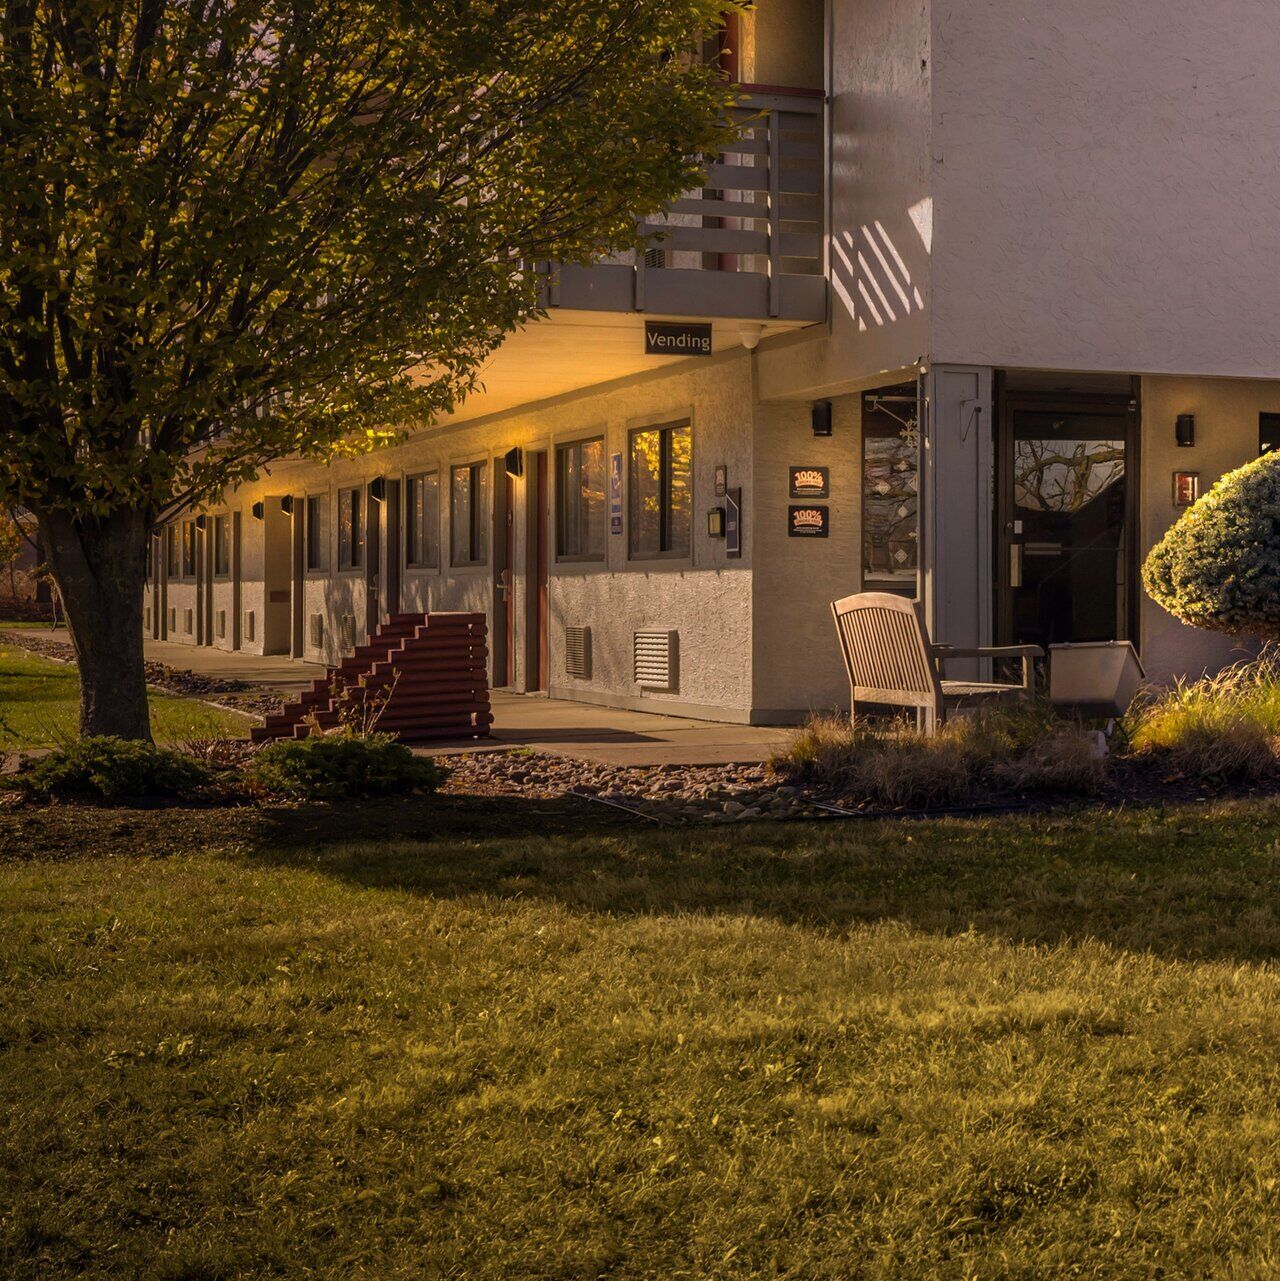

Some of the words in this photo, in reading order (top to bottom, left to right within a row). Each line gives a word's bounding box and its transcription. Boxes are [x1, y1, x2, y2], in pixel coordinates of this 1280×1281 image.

[647, 332, 710, 351] Vending
[794, 471, 823, 481] 100%
[793, 510, 822, 520] 100%
